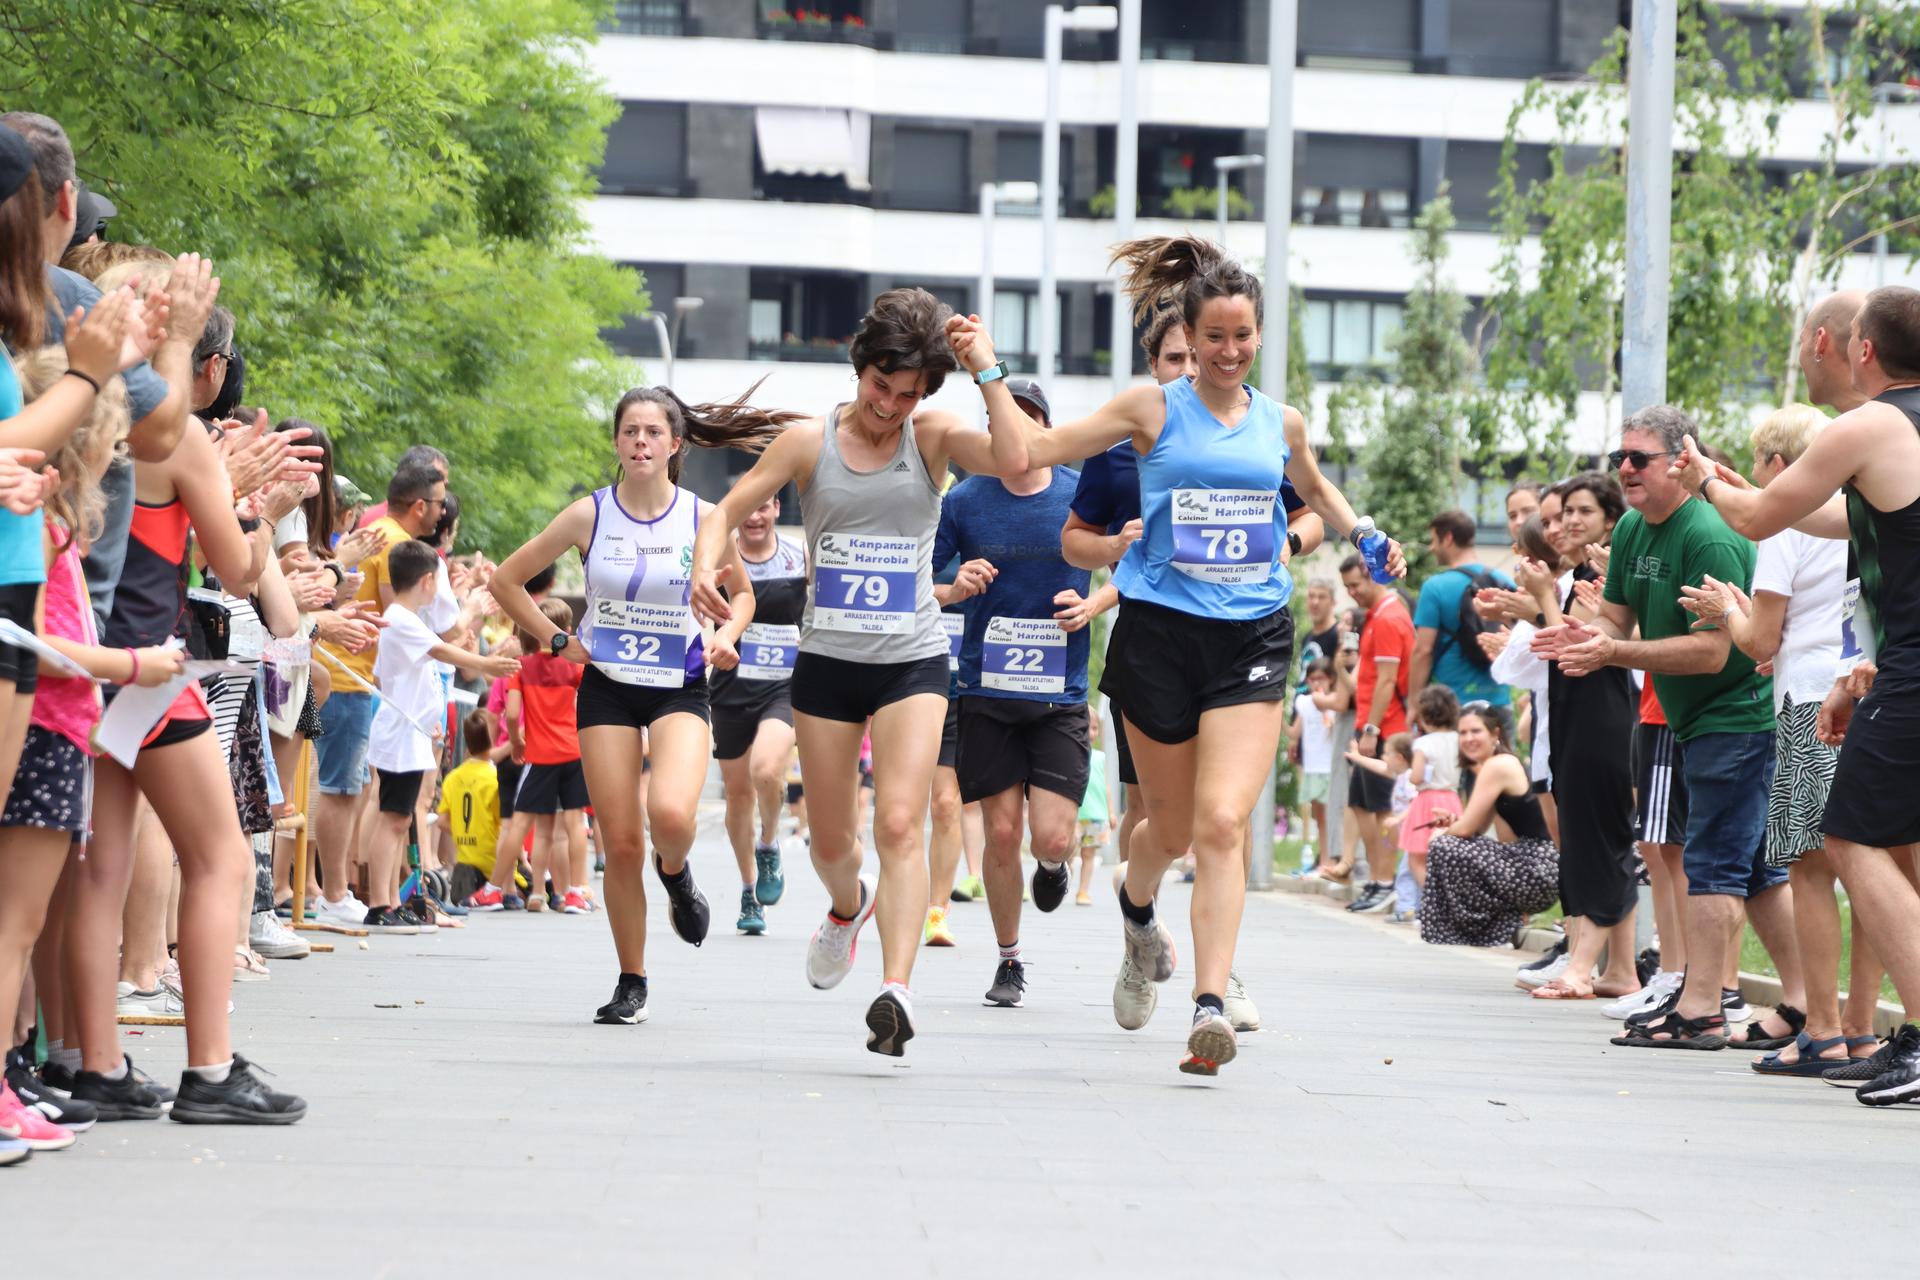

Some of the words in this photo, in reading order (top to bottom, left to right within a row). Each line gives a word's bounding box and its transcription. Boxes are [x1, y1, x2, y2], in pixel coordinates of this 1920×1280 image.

[1209, 493, 1274, 504] Kanpanzar
[1215, 507, 1265, 517] Harrobia
[849, 538, 916, 551] Kanpanzar
[1200, 529, 1249, 560] 78
[821, 558, 849, 566] Calcinor
[855, 554, 909, 564] Harrobia
[1234, 565, 1259, 573] ATLETIKO
[840, 574, 889, 607] 79
[625, 605, 687, 617] Kanpanzar
[844, 612, 873, 620] ARRASATE
[874, 613, 902, 621] ATLETIKO
[598, 619, 625, 627] Calcinor
[631, 617, 680, 629] Harrobia
[861, 623, 884, 631] TALDEA
[1017, 632, 1061, 641] Harrobia
[616, 633, 661, 662] 32
[755, 645, 785, 666] 52
[1004, 647, 1045, 672] 22
[462, 791, 472, 834] 9
